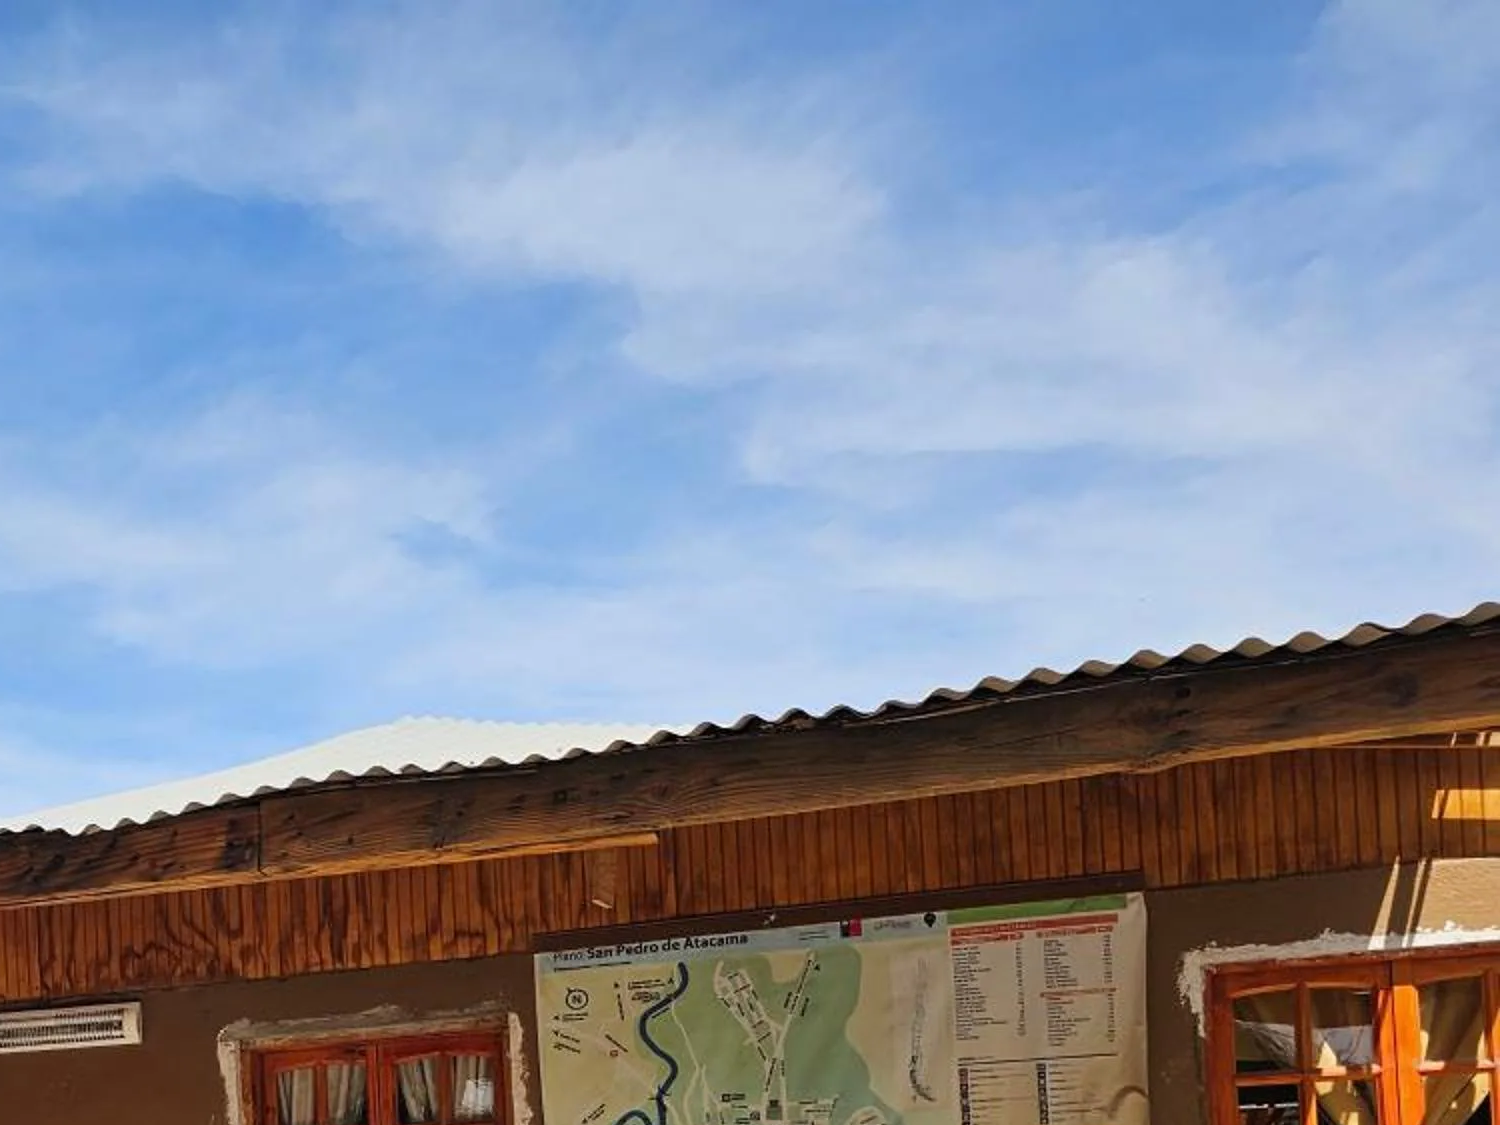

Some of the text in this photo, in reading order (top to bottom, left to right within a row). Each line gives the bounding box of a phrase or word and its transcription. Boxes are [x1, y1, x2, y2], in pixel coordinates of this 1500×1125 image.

[587, 946, 613, 959] San
[616, 942, 659, 957] Pedro
[661, 937, 681, 951] de
[683, 934, 749, 950] Atacama
